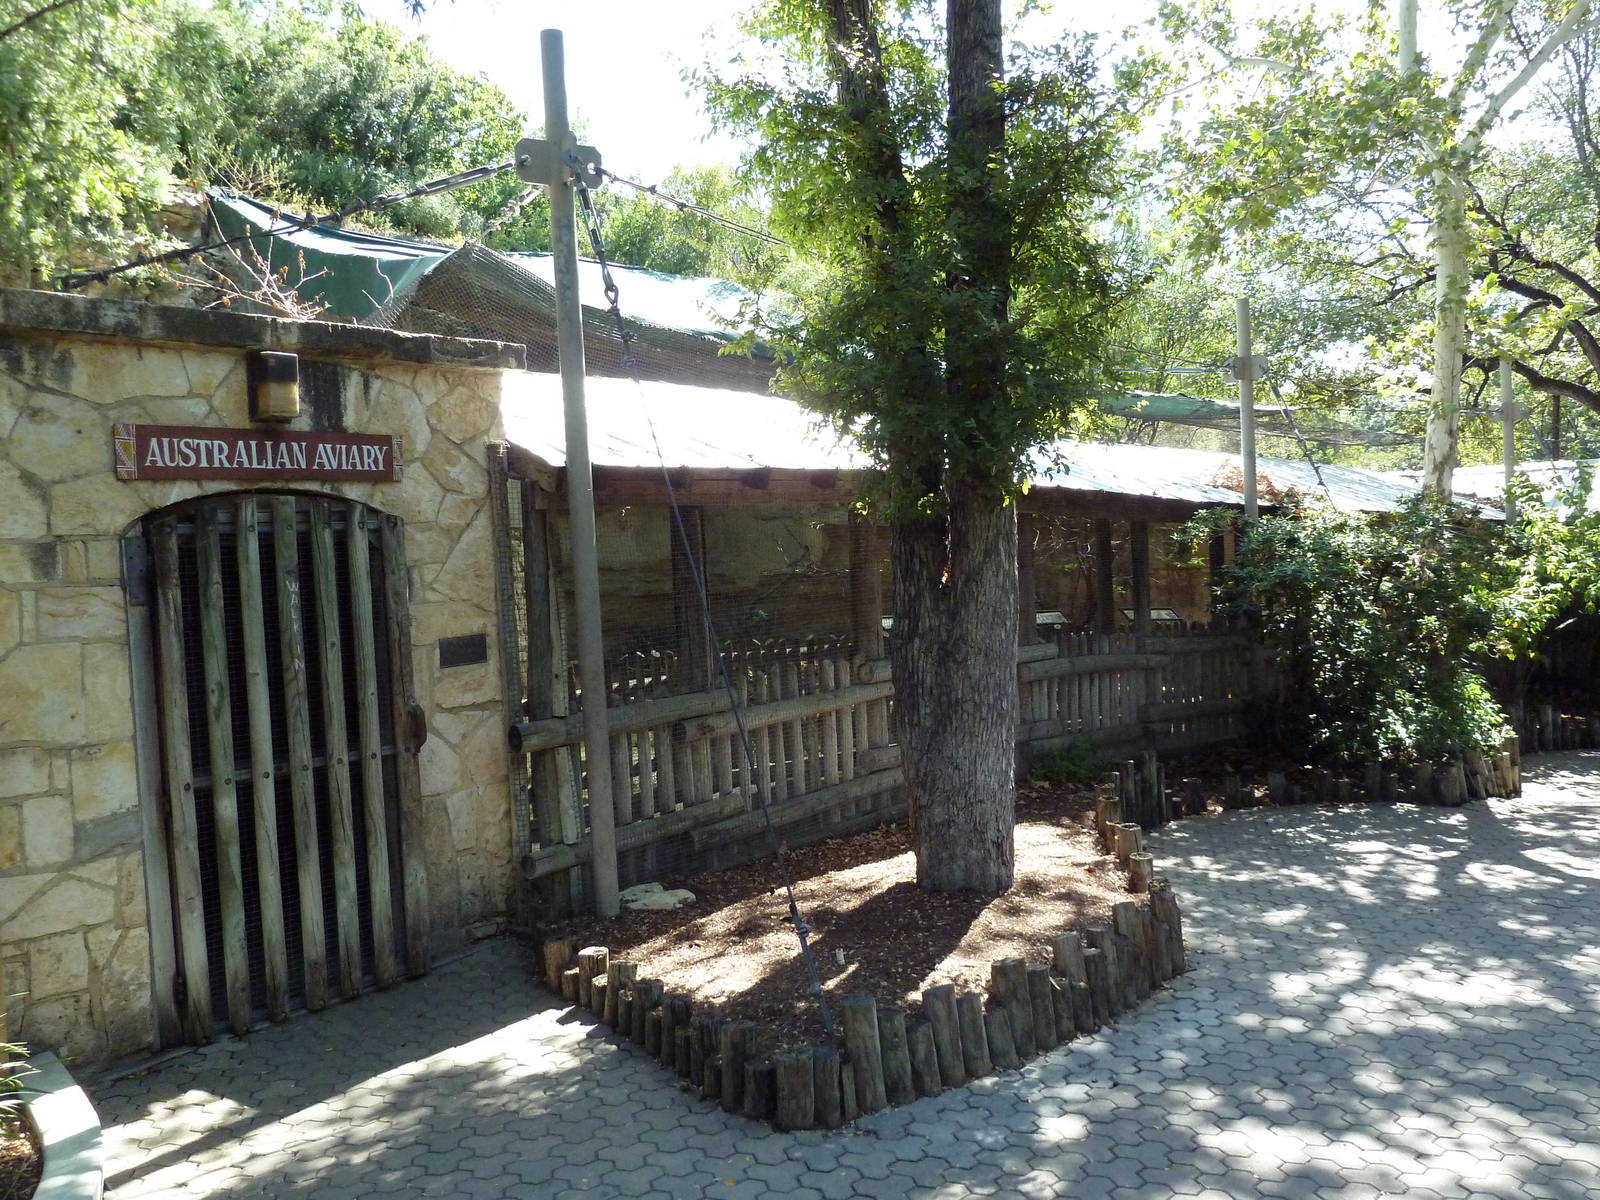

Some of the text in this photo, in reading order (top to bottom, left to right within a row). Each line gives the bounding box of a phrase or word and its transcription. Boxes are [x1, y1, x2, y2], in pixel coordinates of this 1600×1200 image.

[145, 437, 389, 471] AUSTRALIAN AVIARY
[286, 580, 304, 670] WALK IN
